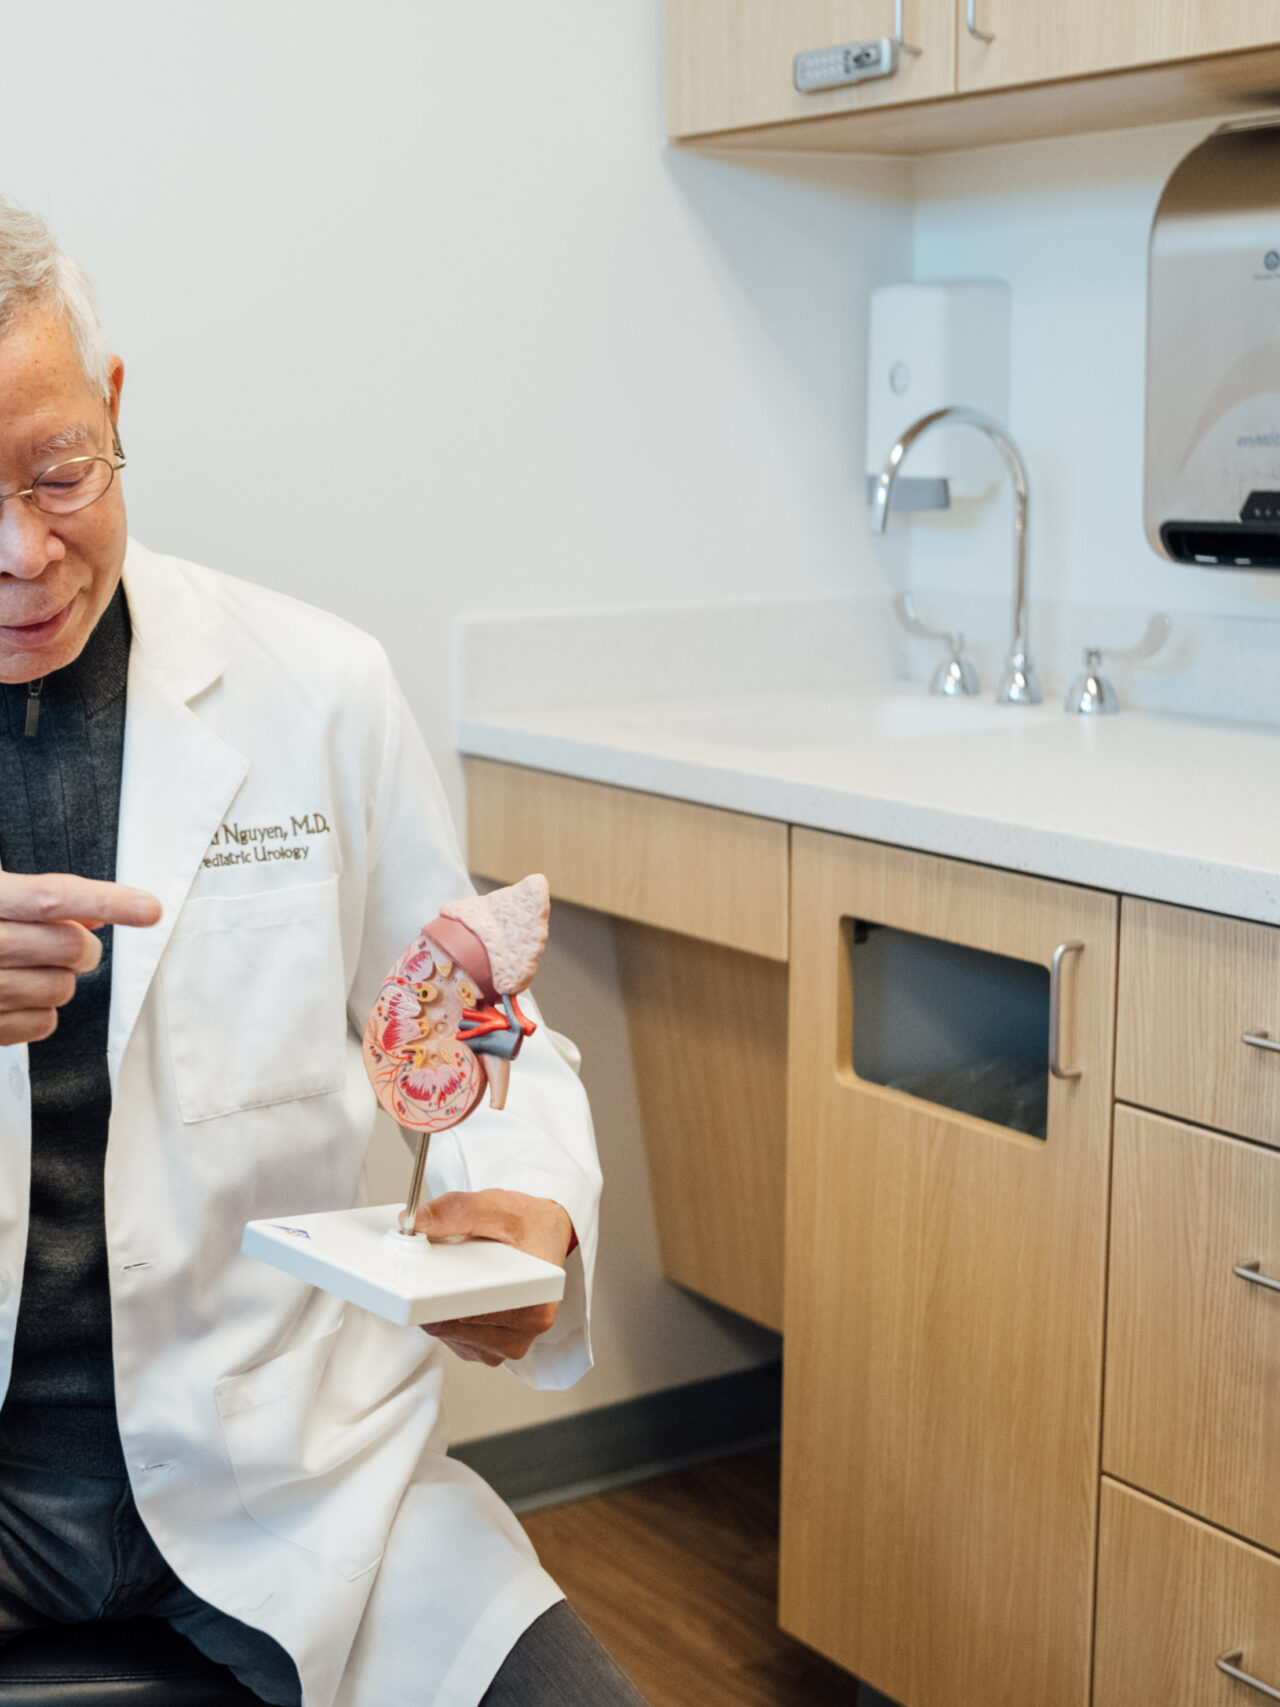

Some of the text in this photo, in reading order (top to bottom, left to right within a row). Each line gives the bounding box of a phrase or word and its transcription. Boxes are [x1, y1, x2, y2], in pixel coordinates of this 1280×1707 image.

[222, 822, 288, 846] Nguyen,
[289, 813, 330, 837] M.D.
[198, 845, 309, 868] ediatric Urology
